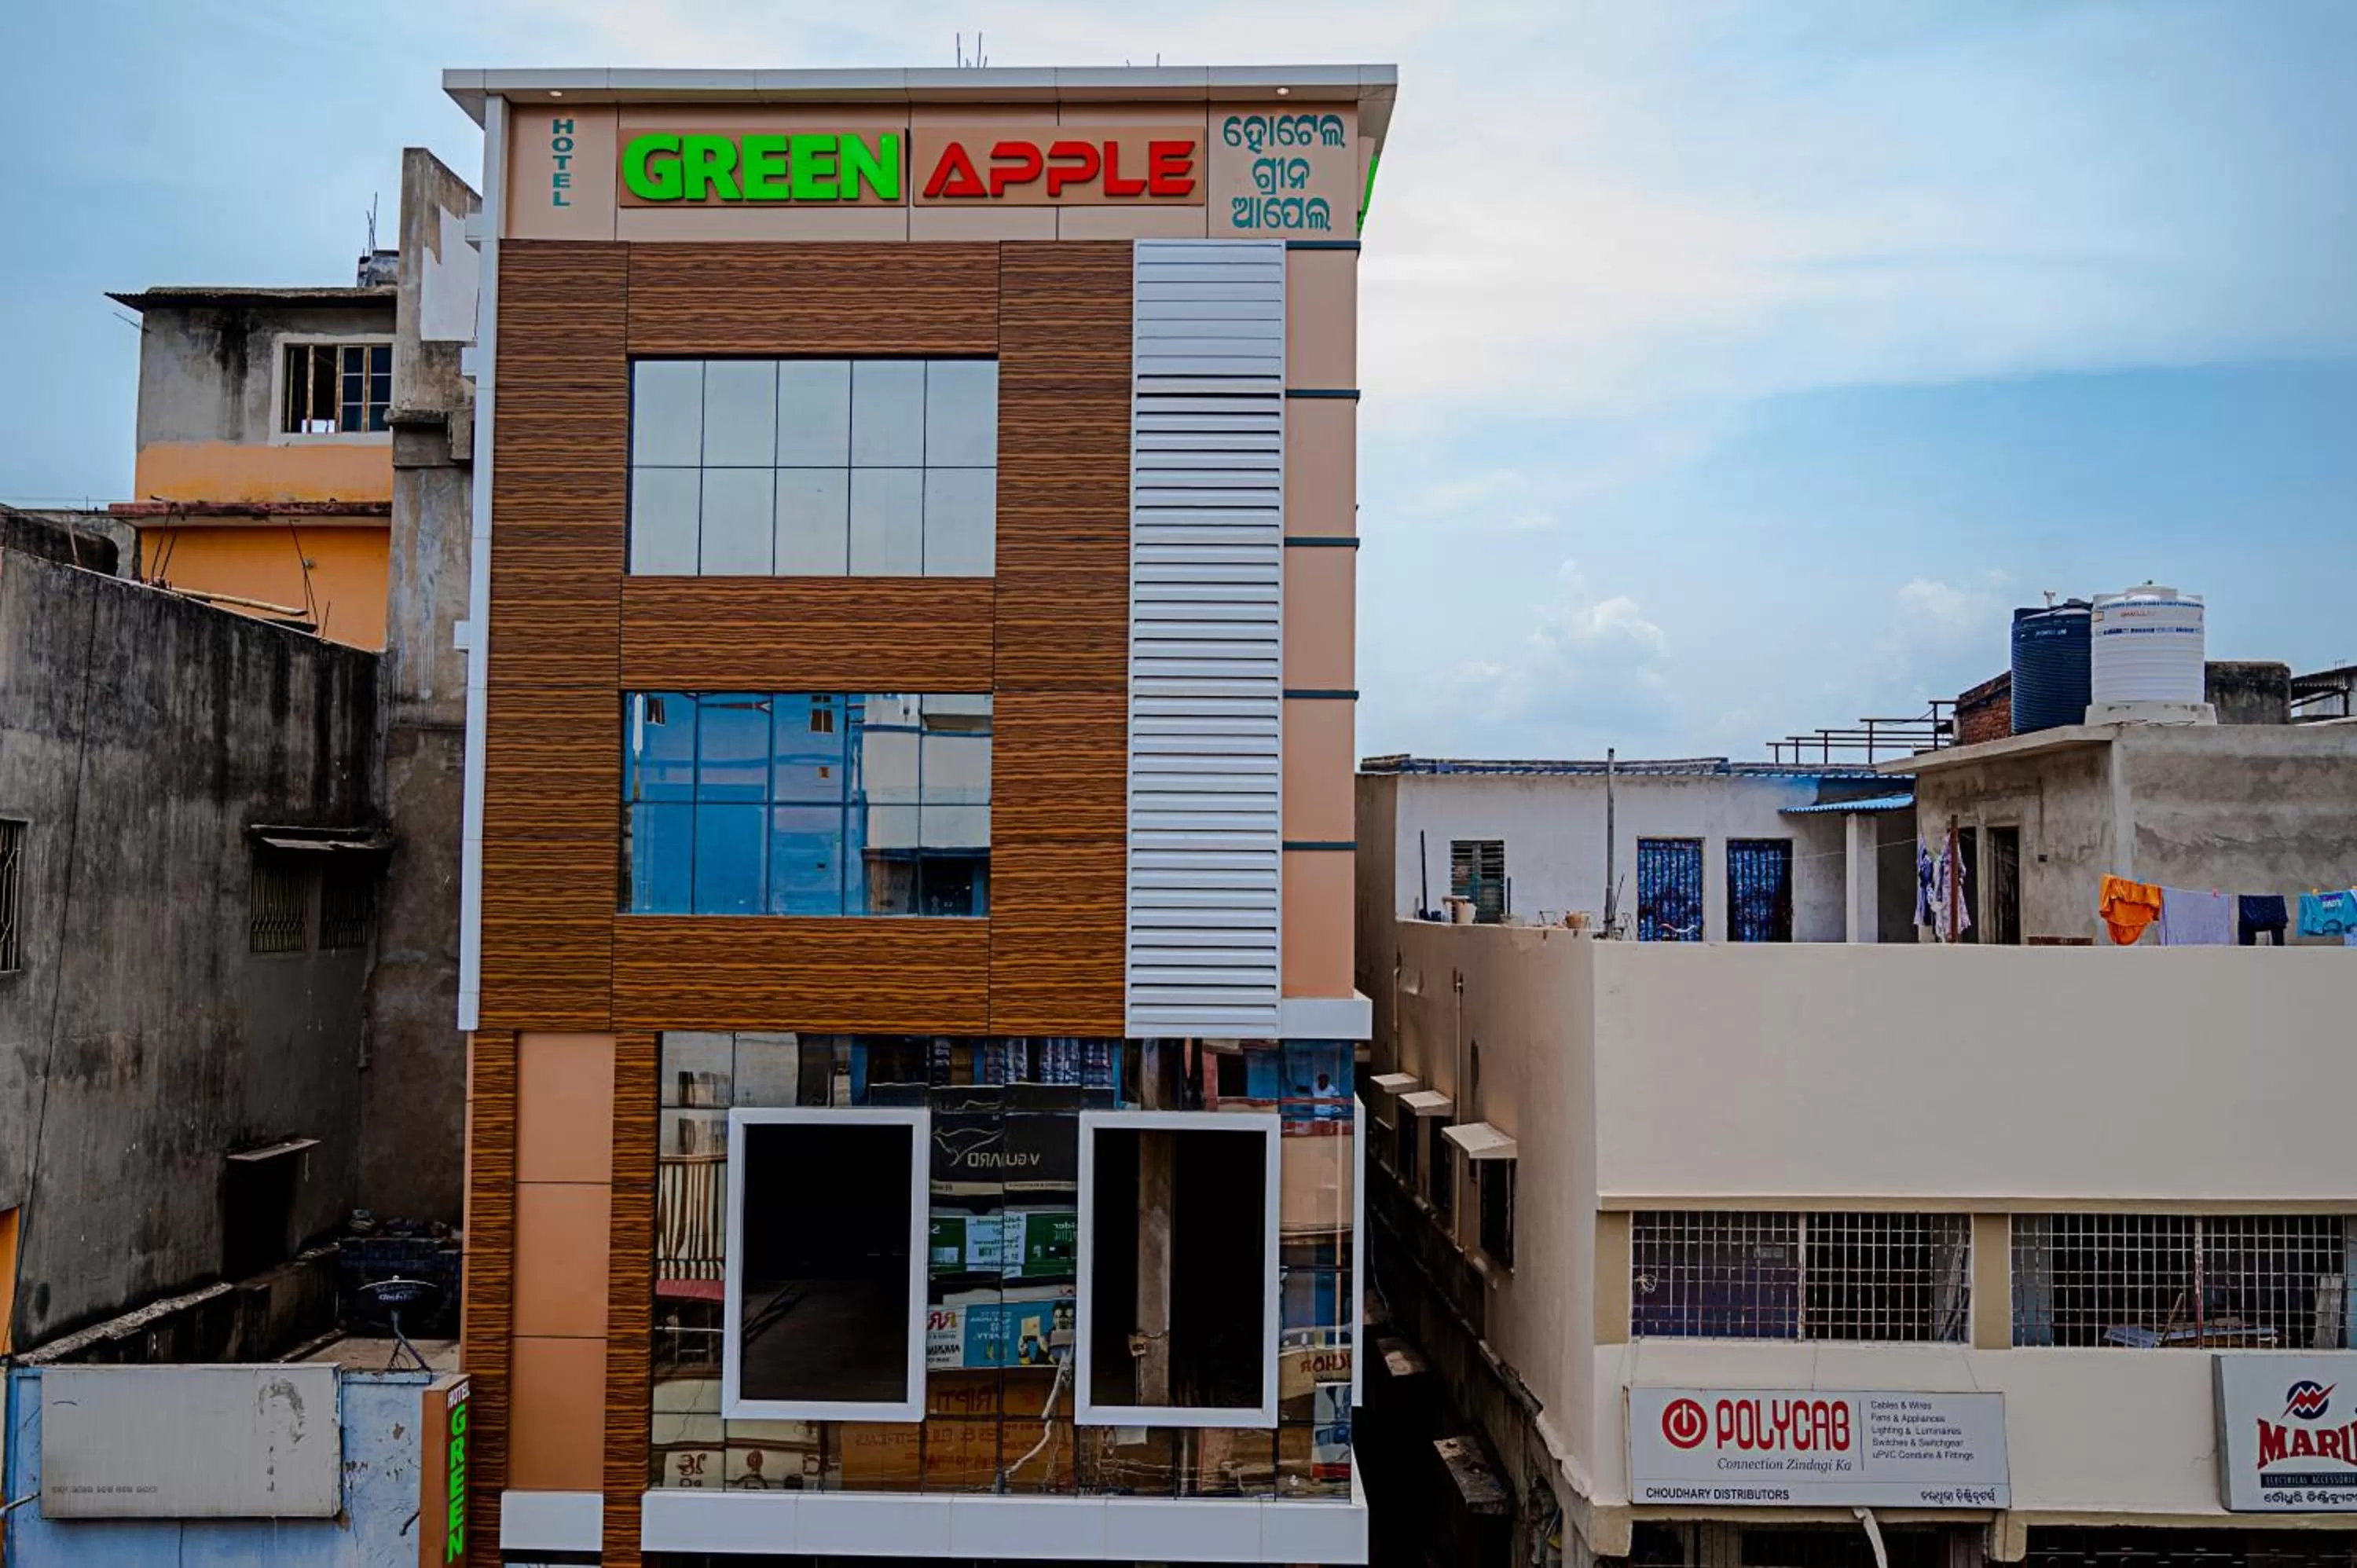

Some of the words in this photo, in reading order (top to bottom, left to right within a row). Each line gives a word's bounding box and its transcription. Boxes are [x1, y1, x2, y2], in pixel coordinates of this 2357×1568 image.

[552, 119, 574, 207] HOTEL
[621, 133, 900, 202] GREEN
[922, 141, 1197, 198] APPLE
[447, 1380, 470, 1410] HOTEL
[1871, 1401, 1898, 1409] Cables
[1716, 1399, 1850, 1451] POLYCAB
[1871, 1427, 1904, 1437] Lighting
[1717, 1457, 1783, 1471] Connection
[1787, 1458, 1833, 1473] Zindagi
[1835, 1460, 1852, 1471] Ka
[447, 1403, 467, 1563] GREEN
[1646, 1488, 1711, 1499] CHOUDHARY
[1714, 1489, 1790, 1500] DISTRIBUTORS
